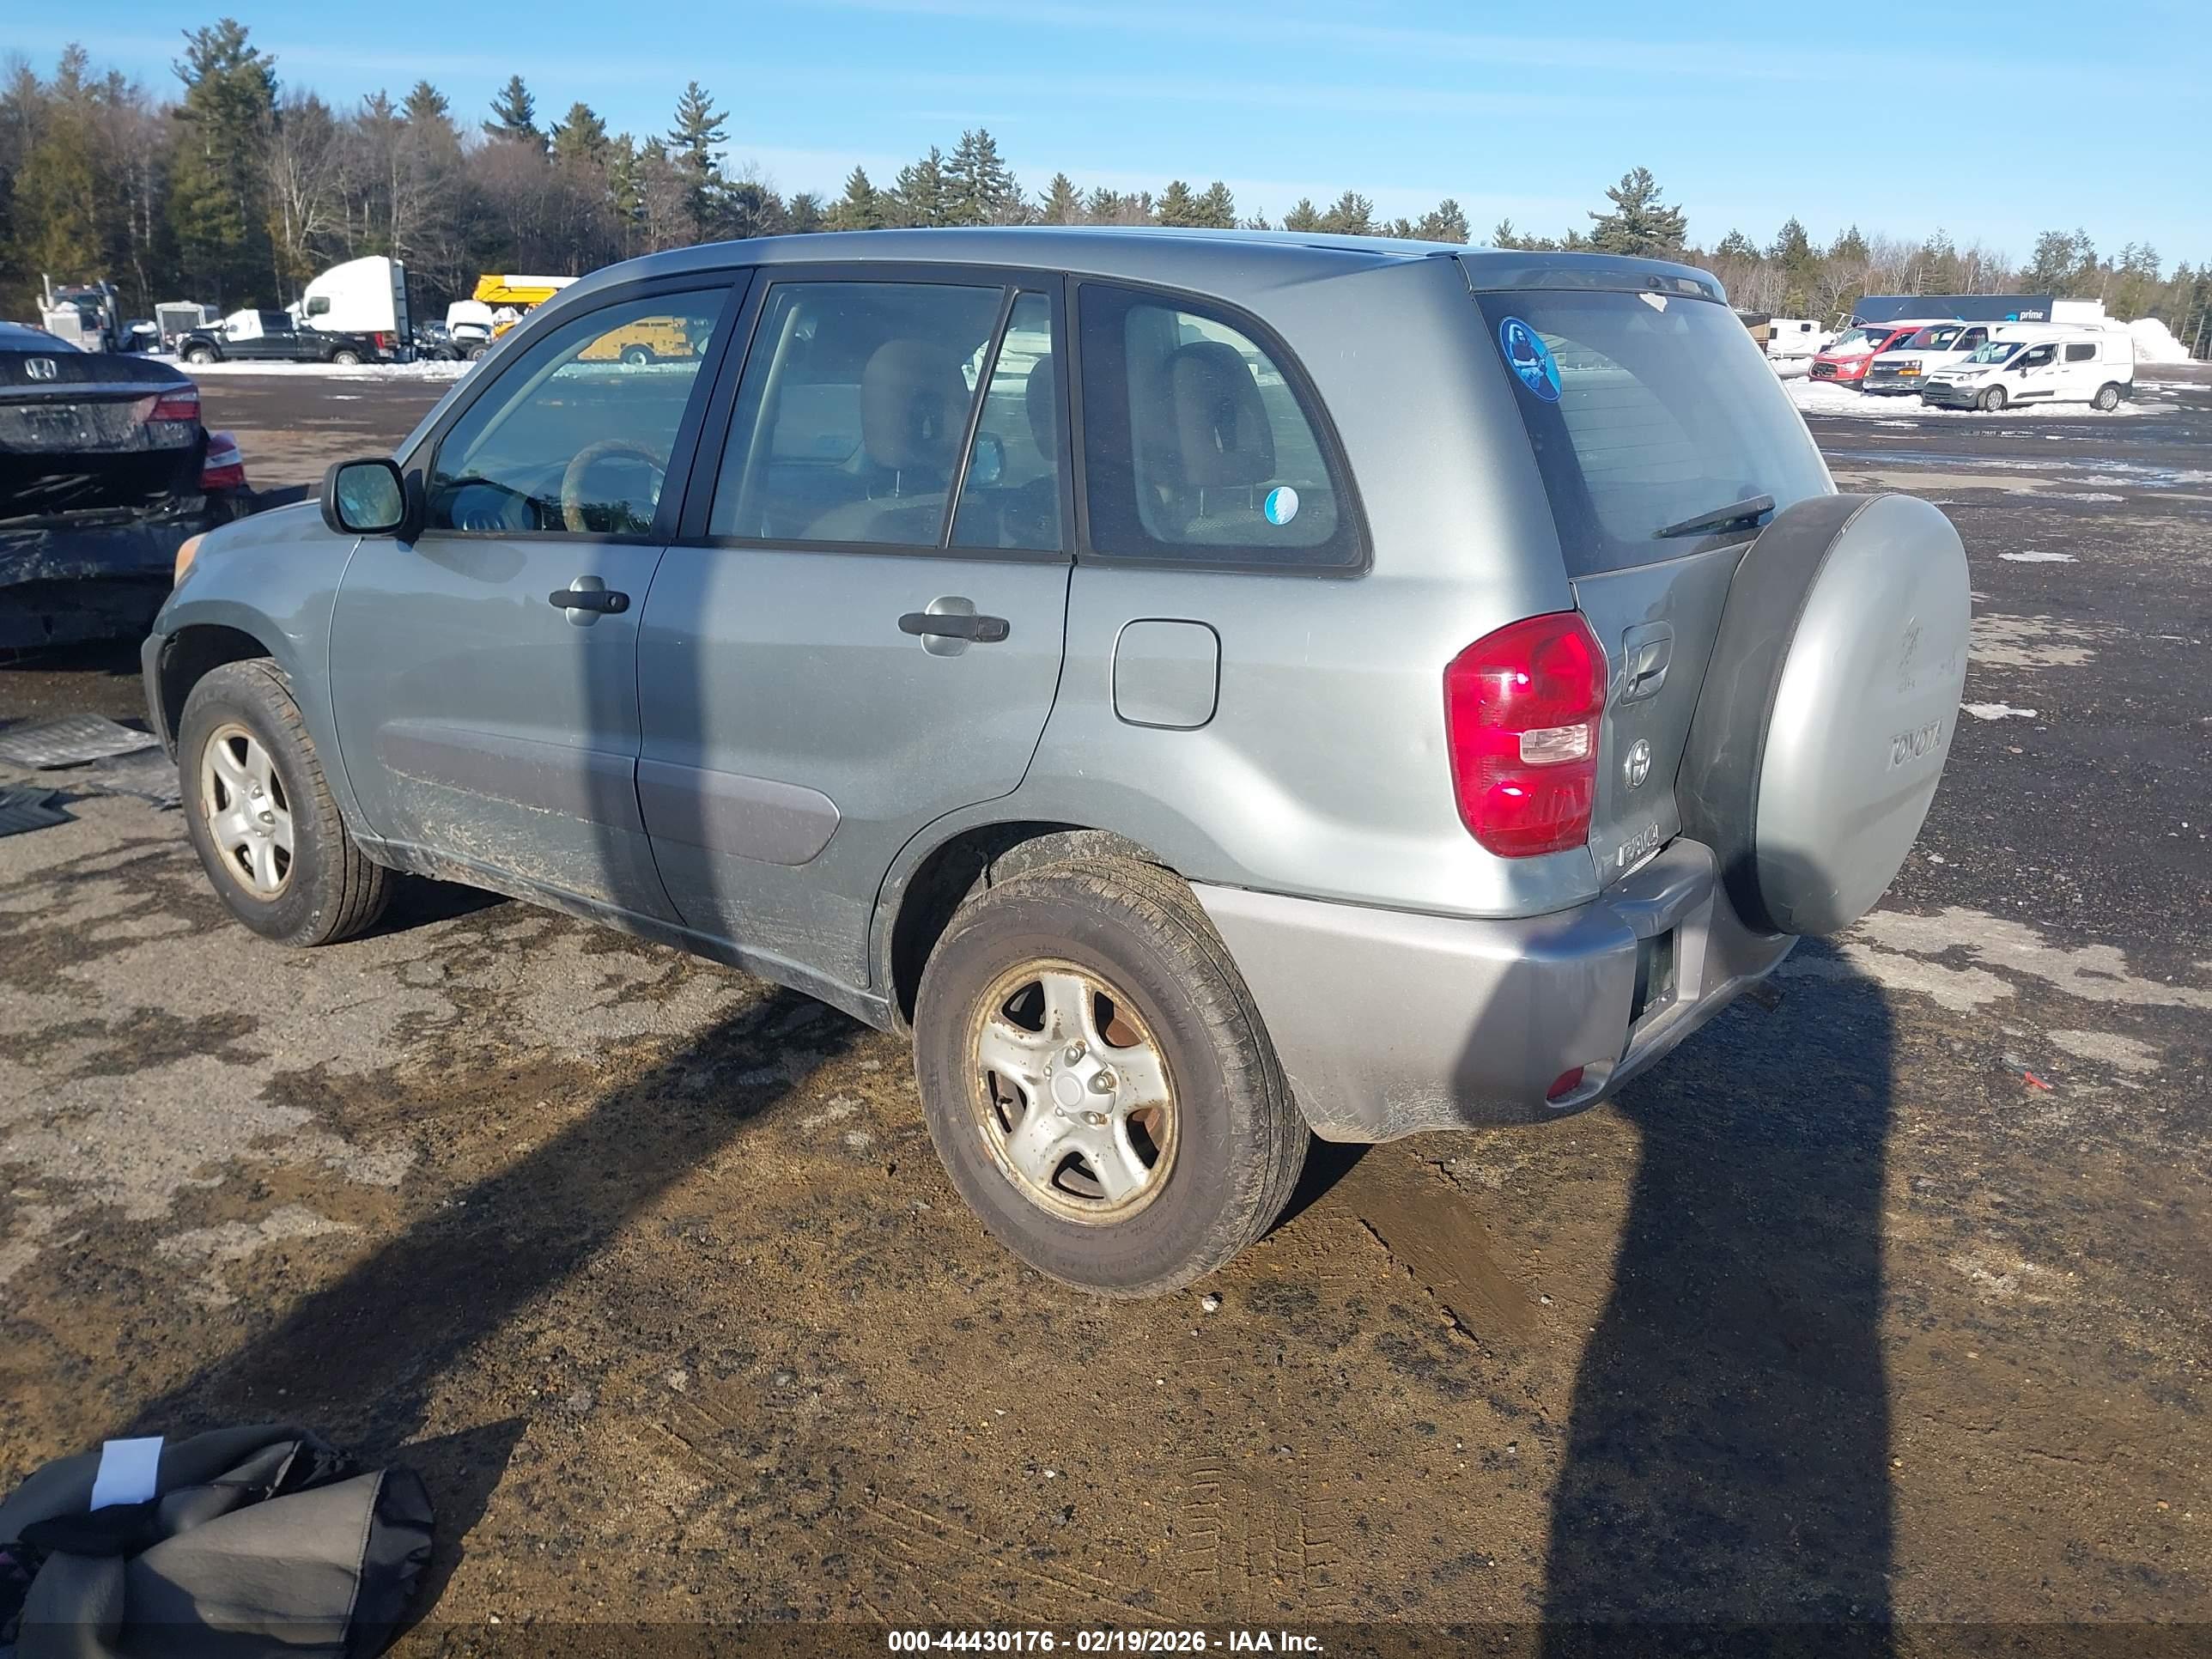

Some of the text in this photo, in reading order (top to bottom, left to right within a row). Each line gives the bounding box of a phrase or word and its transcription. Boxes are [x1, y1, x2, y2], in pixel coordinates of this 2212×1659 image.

[2019, 309, 2044, 321] prime
[1888, 720, 1942, 769] TOYOTA
[1615, 821, 1659, 866] RAV4
